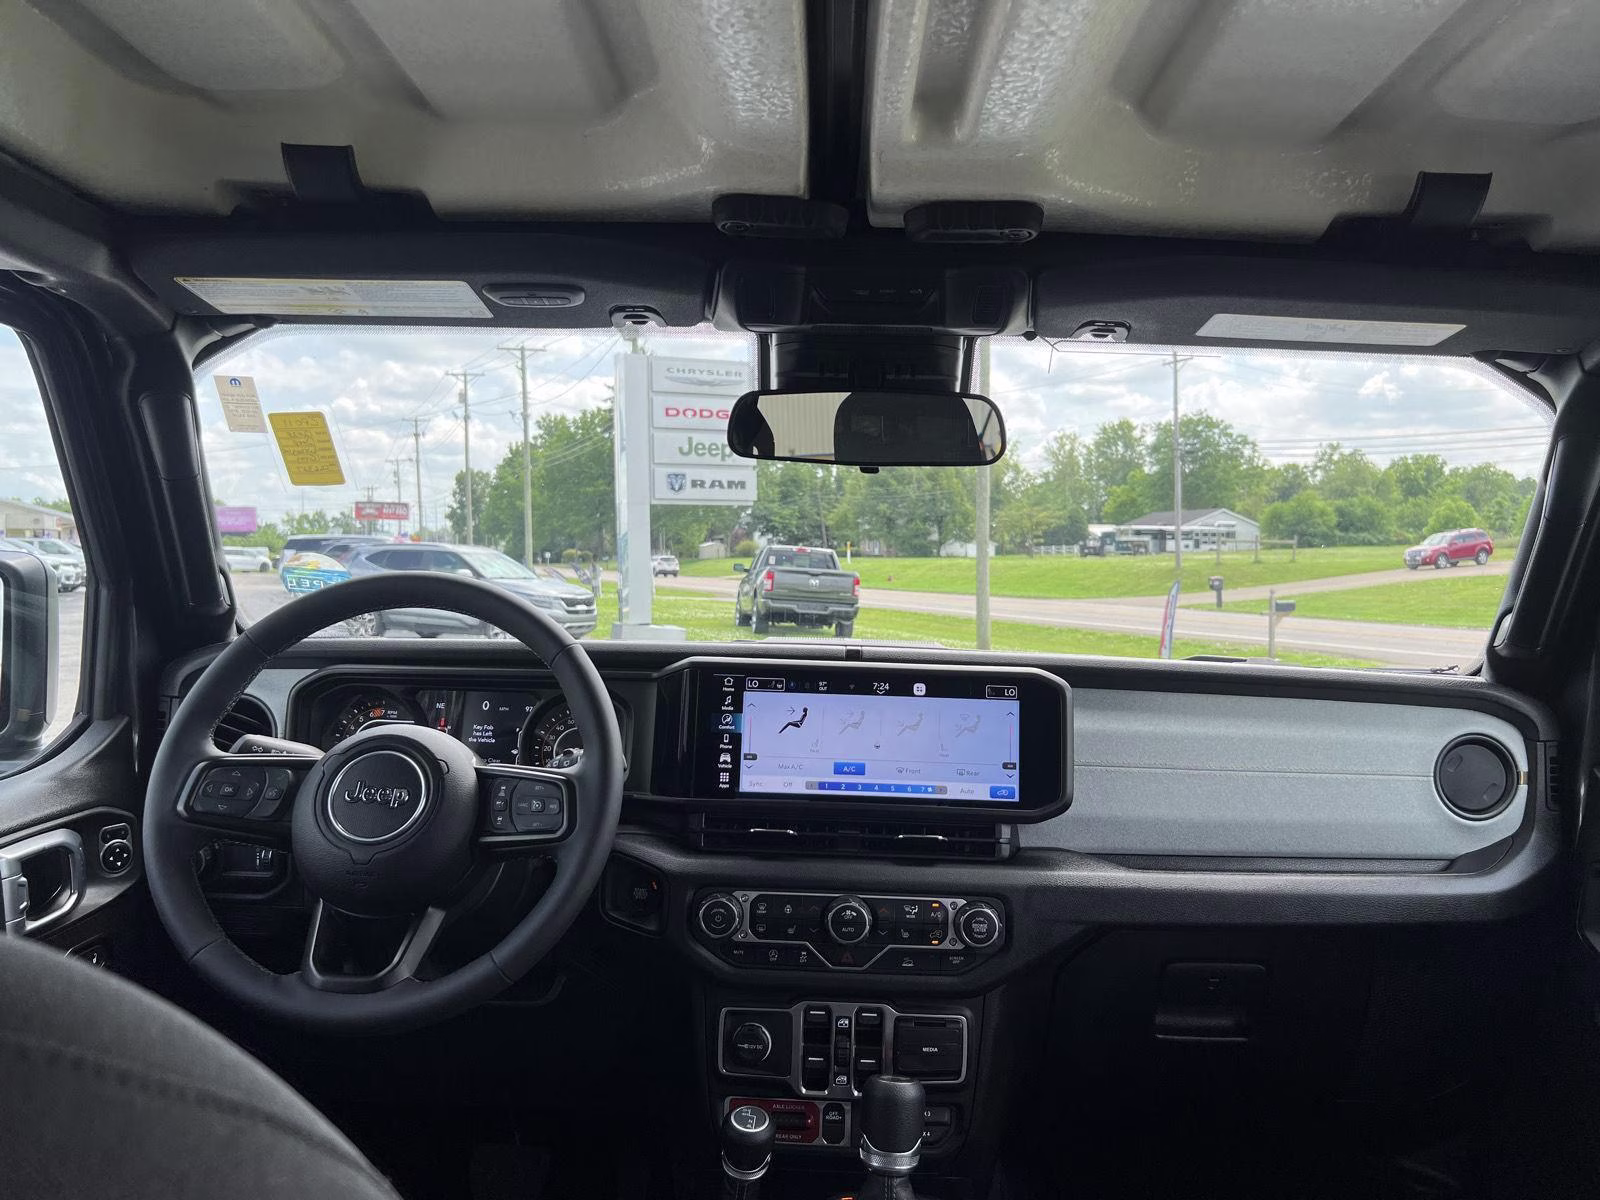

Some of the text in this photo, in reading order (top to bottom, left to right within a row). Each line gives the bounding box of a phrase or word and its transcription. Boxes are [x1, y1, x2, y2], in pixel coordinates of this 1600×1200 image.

[666, 367, 743, 378] CHRYSLER
[665, 407, 730, 420] DODG
[678, 436, 734, 461] Jeep
[691, 479, 747, 490] RAM
[748, 680, 759, 688] LO
[872, 682, 890, 690] 7:24
[482, 700, 490, 711] 0
[345, 781, 409, 807] Jeep
